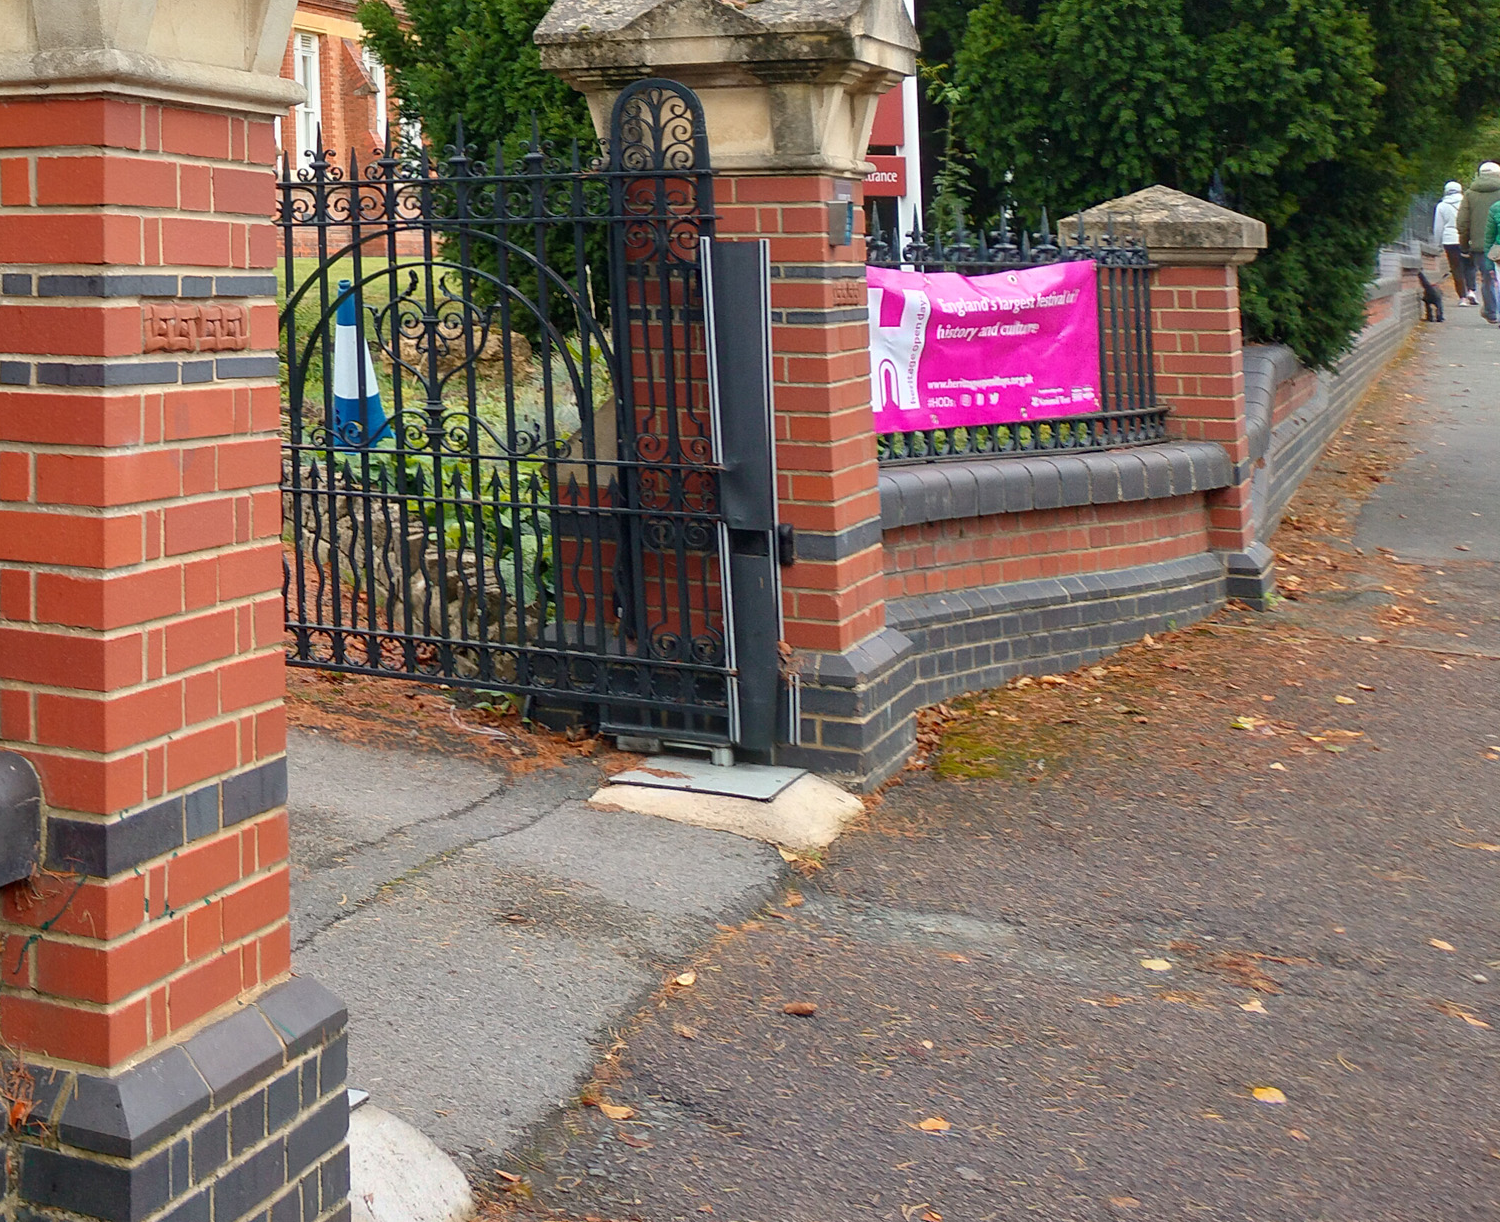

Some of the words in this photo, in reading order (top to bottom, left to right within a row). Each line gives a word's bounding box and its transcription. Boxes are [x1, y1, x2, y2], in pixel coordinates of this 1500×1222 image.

[861, 171, 898, 183] trance
[936, 297, 997, 317] England's
[999, 297, 1036, 313] largest
[912, 322, 922, 352] open
[936, 324, 978, 342] history
[978, 322, 999, 338] and
